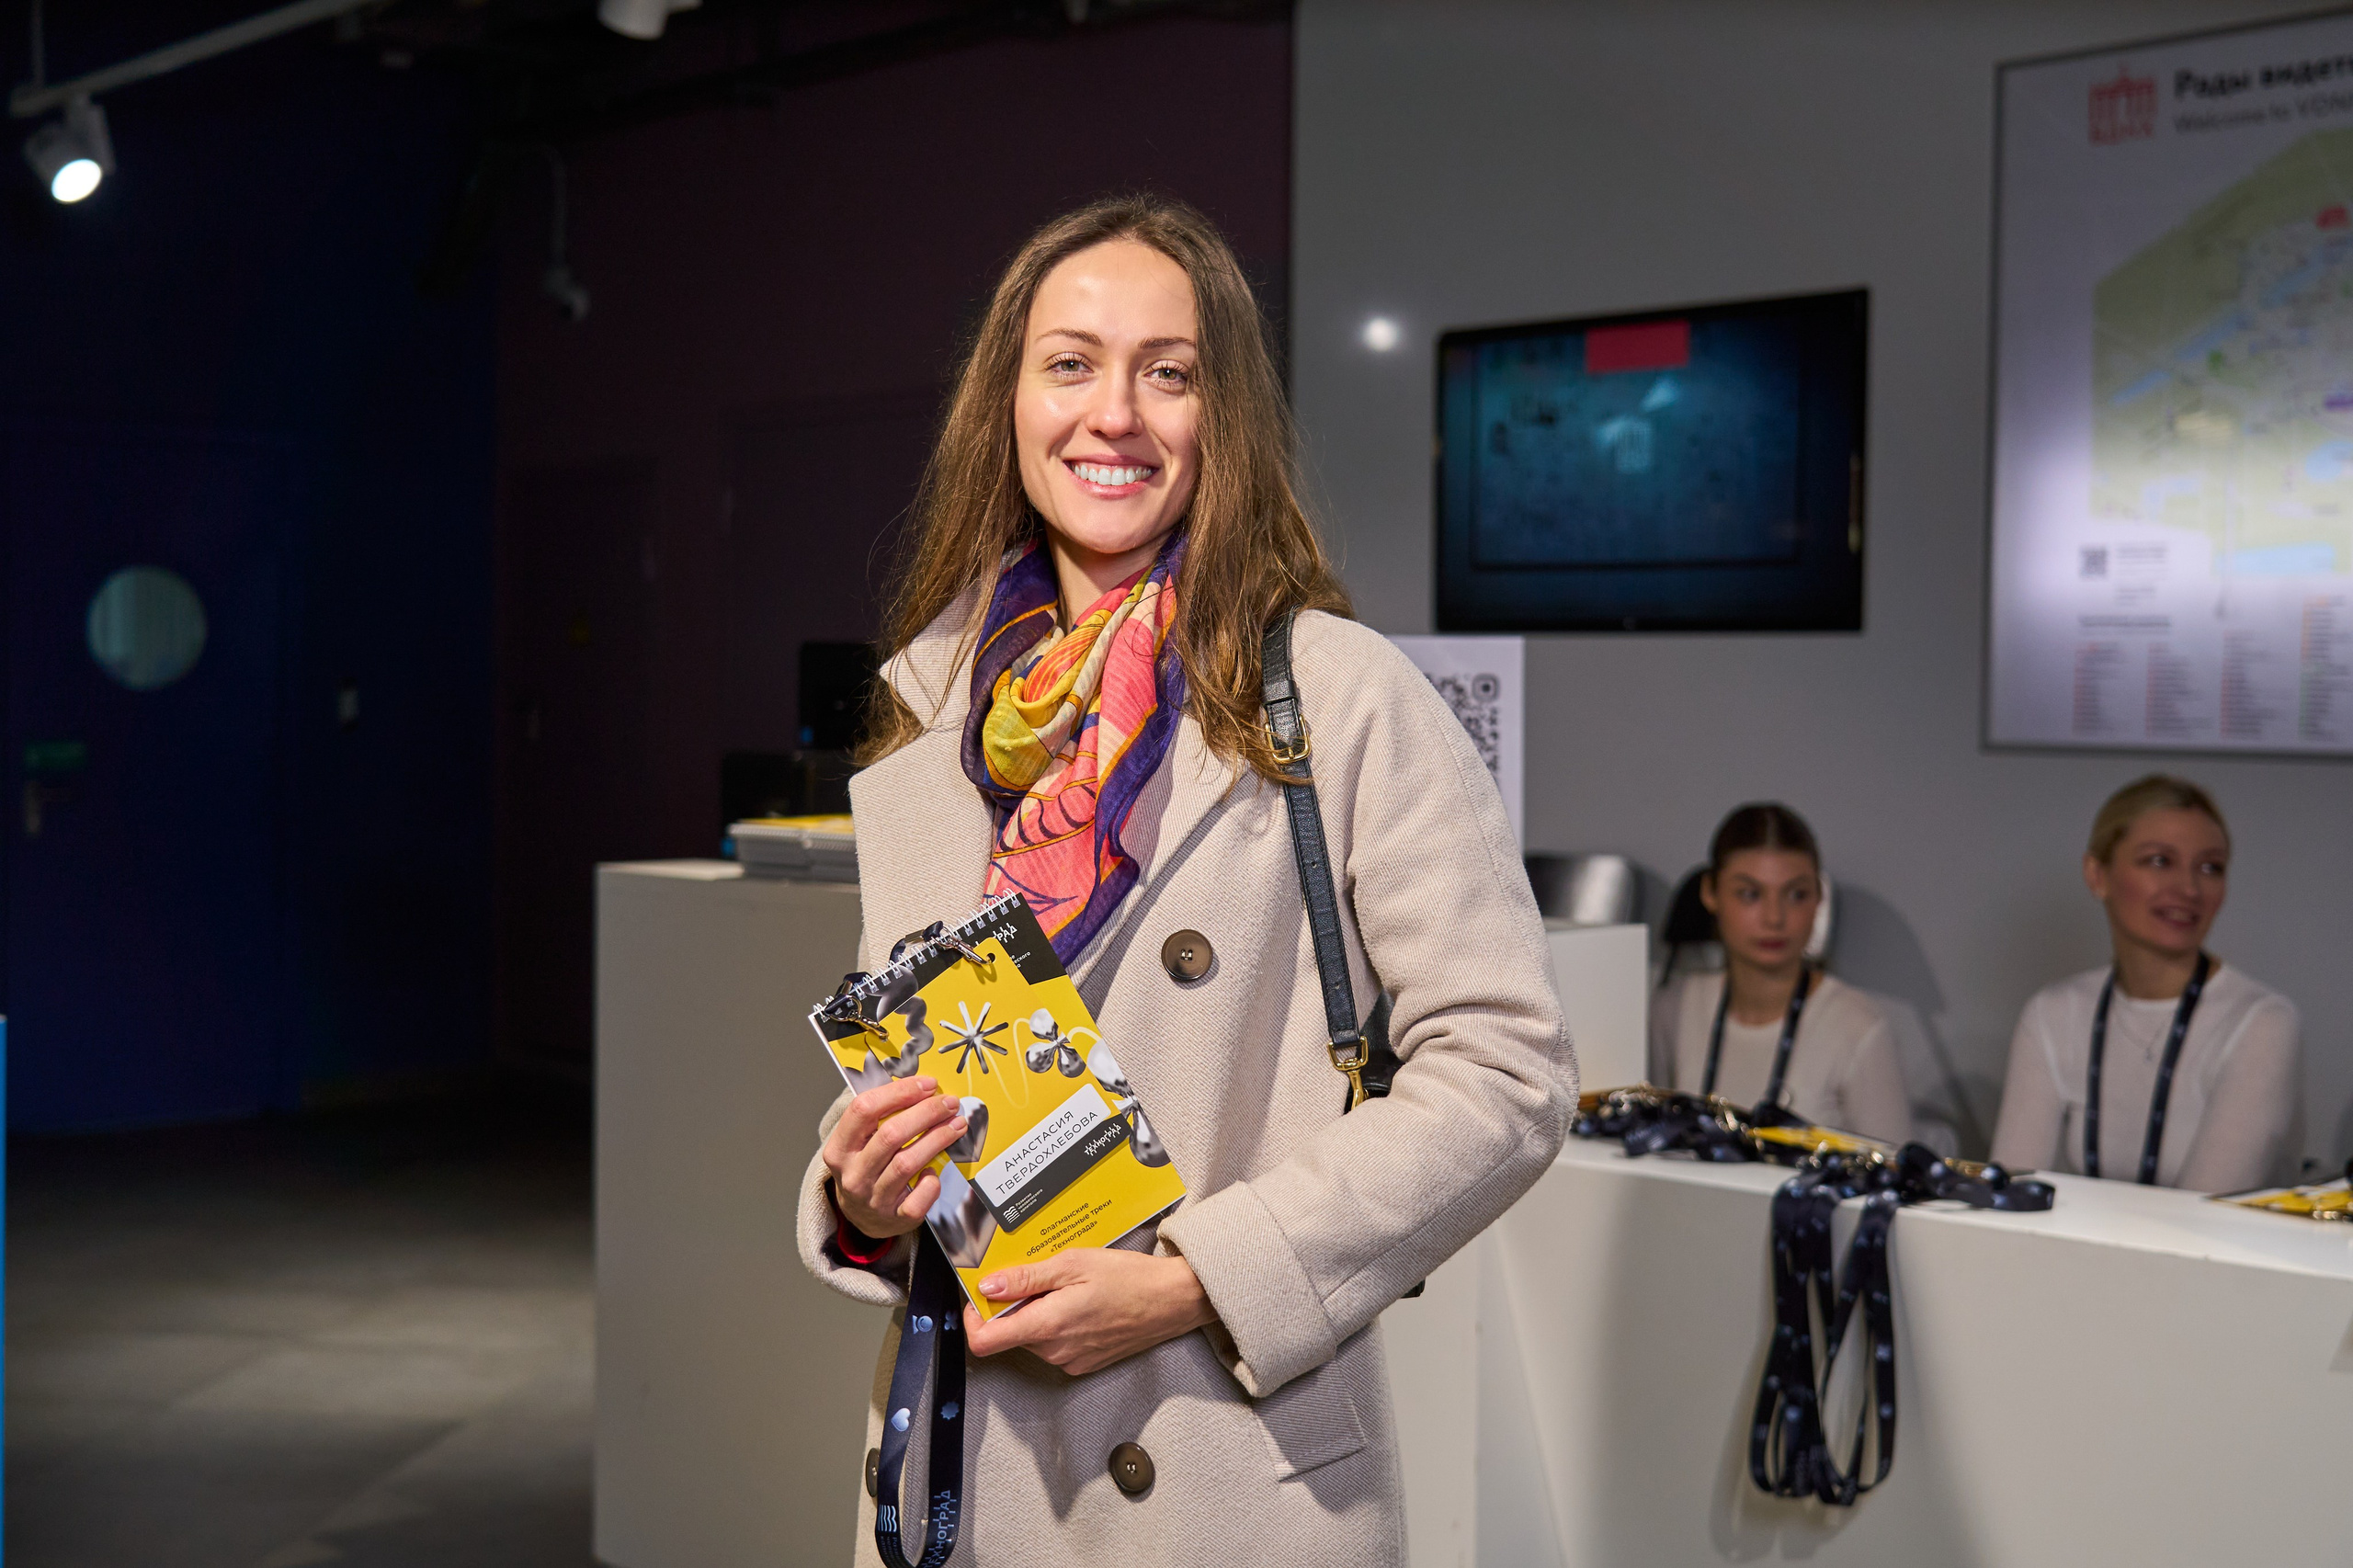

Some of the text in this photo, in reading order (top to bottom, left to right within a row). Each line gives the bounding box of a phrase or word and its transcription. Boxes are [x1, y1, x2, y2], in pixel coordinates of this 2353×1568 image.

[2174, 69, 2250, 102] Рады
[995, 1111, 1098, 1195] ТВЕРДОХЛЕБОВА
[1004, 1110, 1074, 1172] АНАСТАСИЯ
[1084, 1122, 1122, 1156] ТЕХНОГРАД
[1026, 1199, 1113, 1256] образовательные треки
[1040, 1202, 1089, 1236] Флагманские
[1050, 1220, 1097, 1253] «Технограда»
